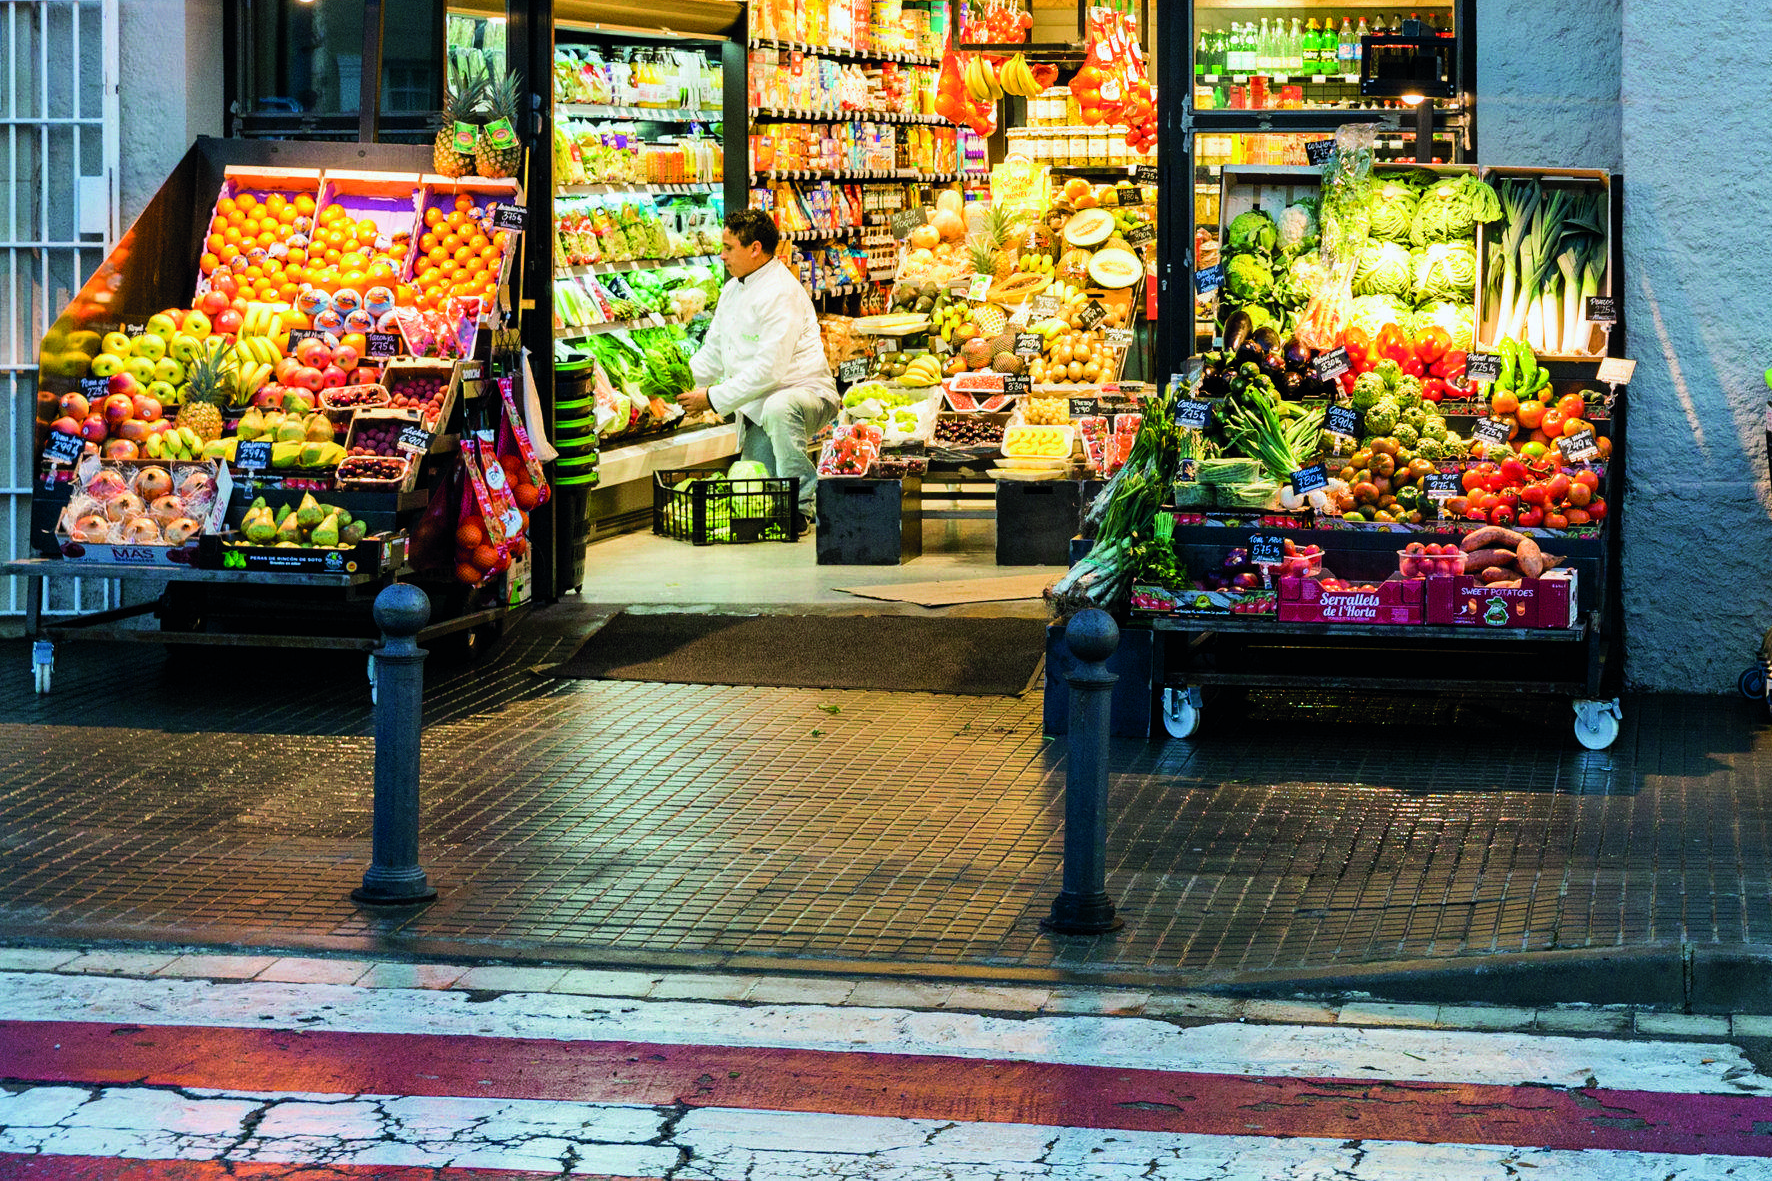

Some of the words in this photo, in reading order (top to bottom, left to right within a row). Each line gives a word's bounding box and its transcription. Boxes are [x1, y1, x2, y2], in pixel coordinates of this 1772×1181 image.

[112, 548, 154, 559] MAS
[1461, 587, 1489, 596] SWEET
[1491, 587, 1534, 597] POTATOES
[1320, 592, 1380, 607] Serrallets
[1323, 605, 1336, 617] de
